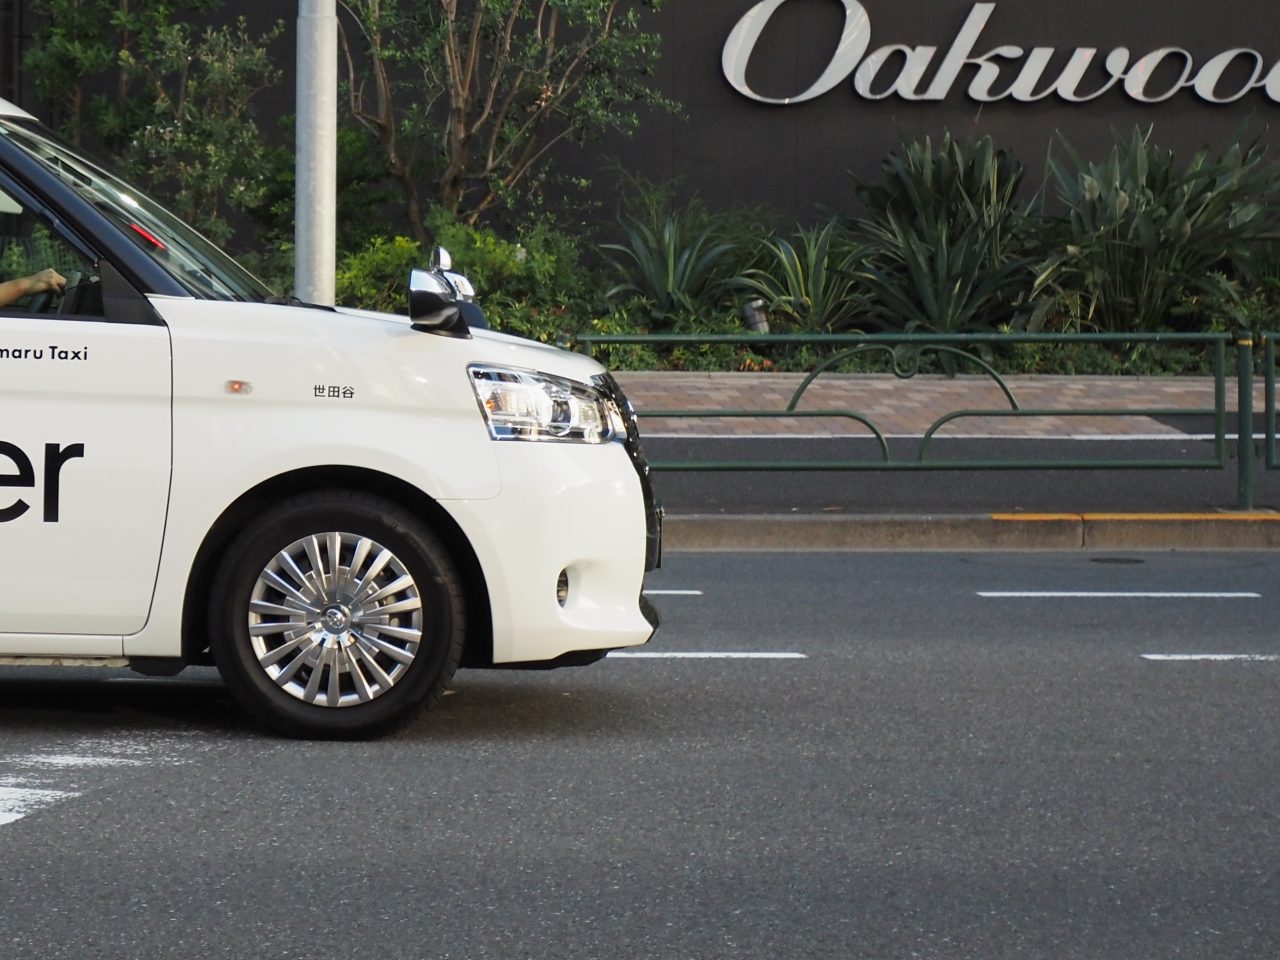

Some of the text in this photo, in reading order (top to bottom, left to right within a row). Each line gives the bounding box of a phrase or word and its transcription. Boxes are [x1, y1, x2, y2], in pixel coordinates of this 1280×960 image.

[48, 345, 88, 361] Taxi
[313, 384, 355, 399] 世田谷
